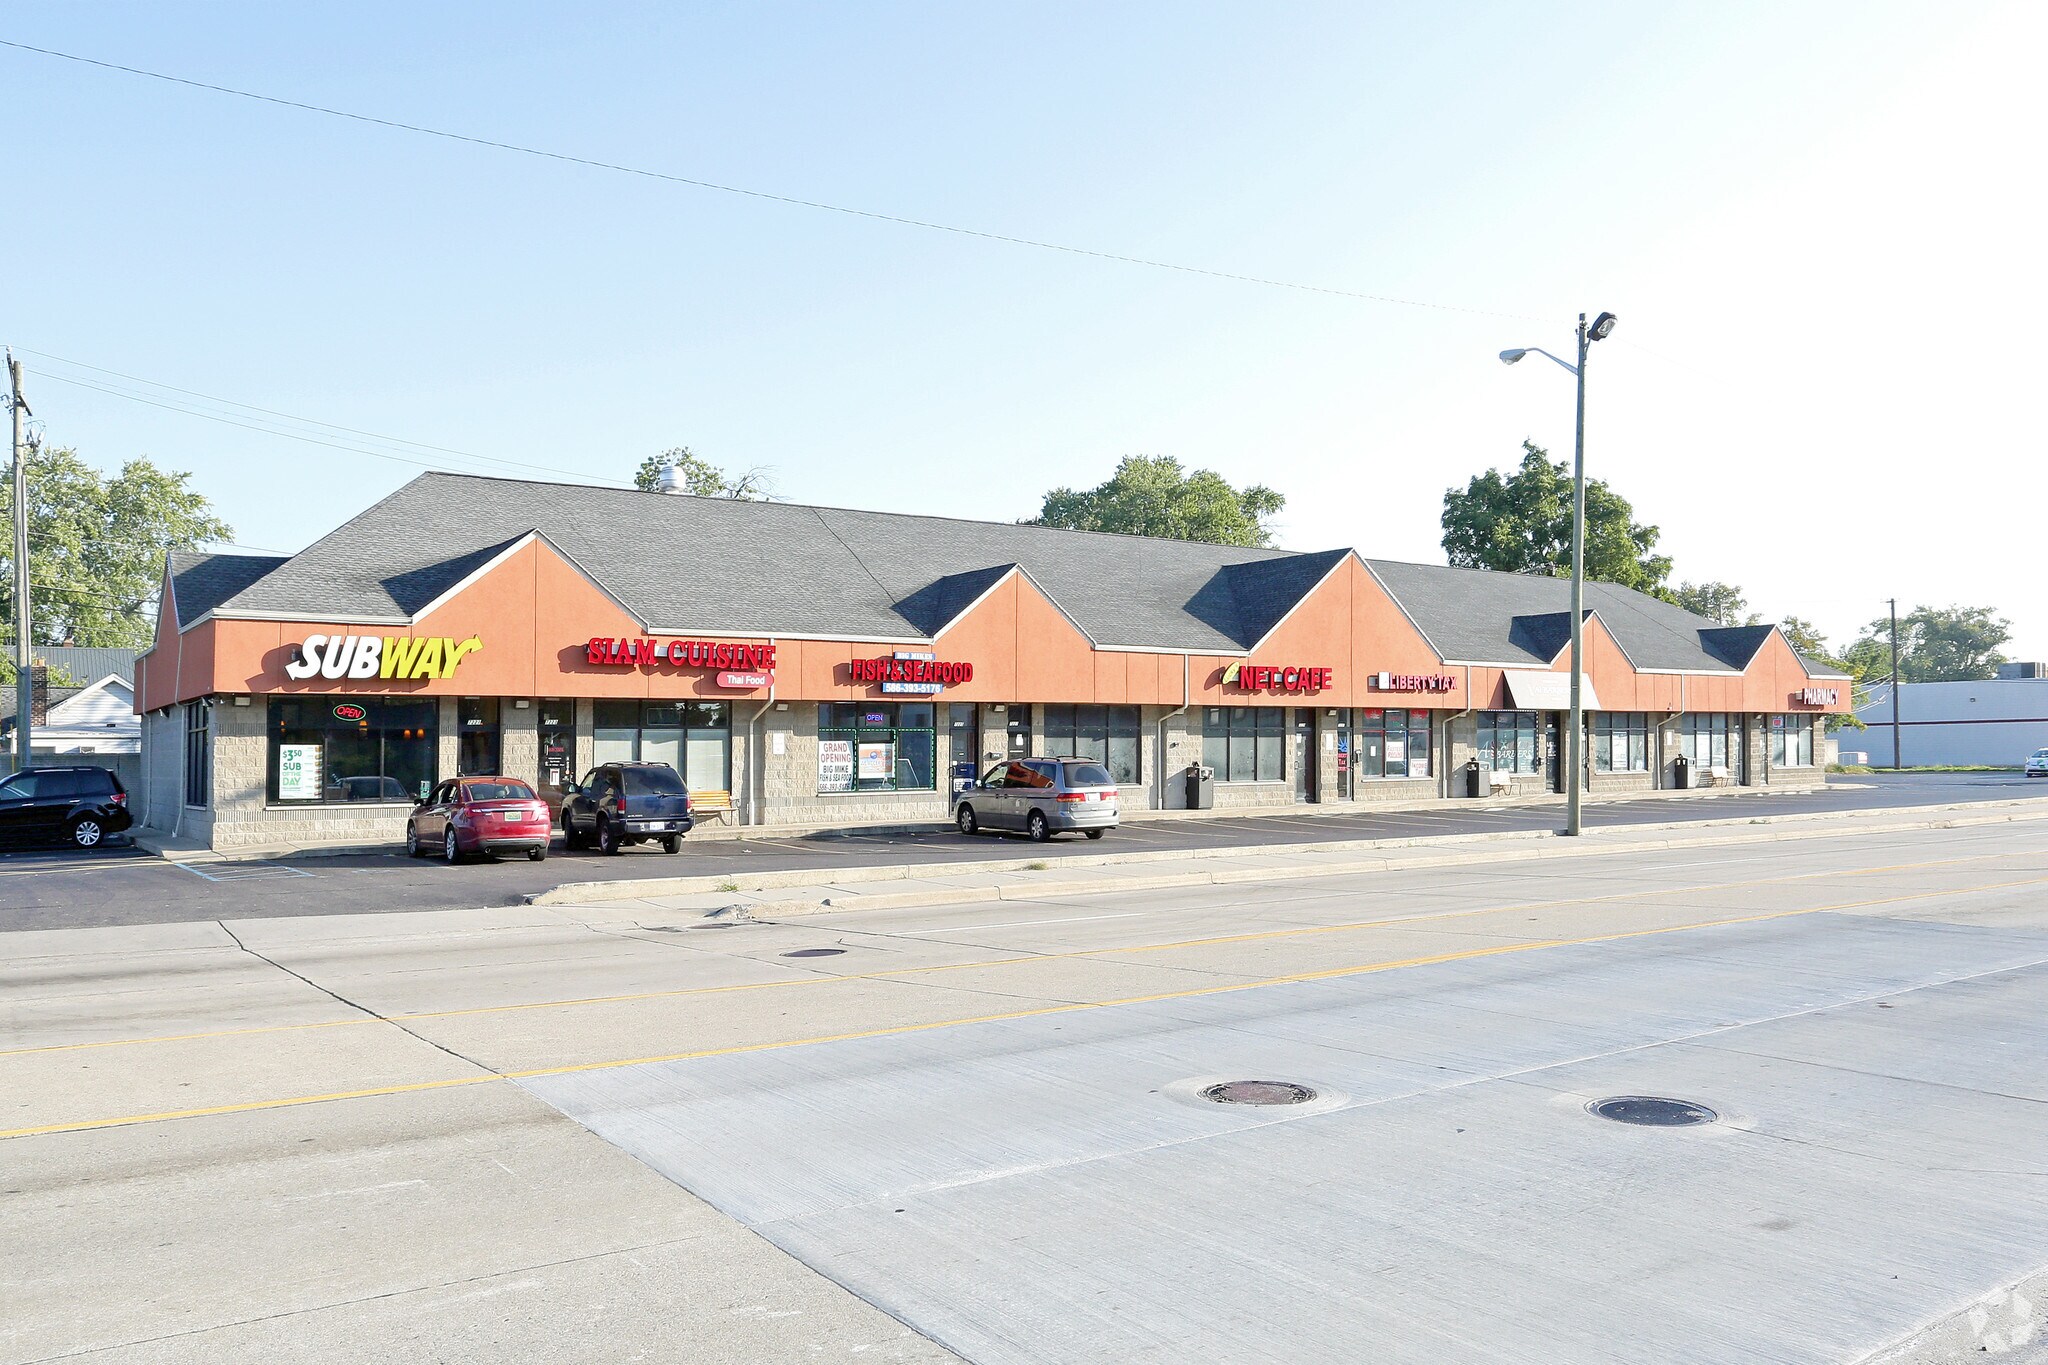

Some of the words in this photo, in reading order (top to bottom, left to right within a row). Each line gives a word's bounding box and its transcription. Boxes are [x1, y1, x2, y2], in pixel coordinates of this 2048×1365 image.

[285, 634, 484, 681] SUBWAY
[588, 637, 657, 665] SIAM
[668, 640, 776, 669] CUISINE
[896, 652, 909, 660] BIG
[852, 659, 888, 681] FISH
[889, 660, 902, 681] &
[903, 660, 973, 682] SEAFOOD
[727, 674, 744, 685] Thai
[745, 675, 766, 685] Food
[1240, 666, 1279, 690] NET
[1282, 666, 1333, 690] CAFE
[1389, 672, 1435, 690] LIBERTY
[1435, 672, 1457, 690] TAX
[886, 682, 941, 693] 586-393-5176
[1803, 688, 1839, 705] PHARMACY
[336, 706, 361, 718] OPEN
[823, 743, 848, 752] GRAND
[820, 754, 852, 763] OPENING
[282, 762, 301, 770] SUB
[823, 765, 833, 773] BIG
[282, 778, 301, 786] DAY
